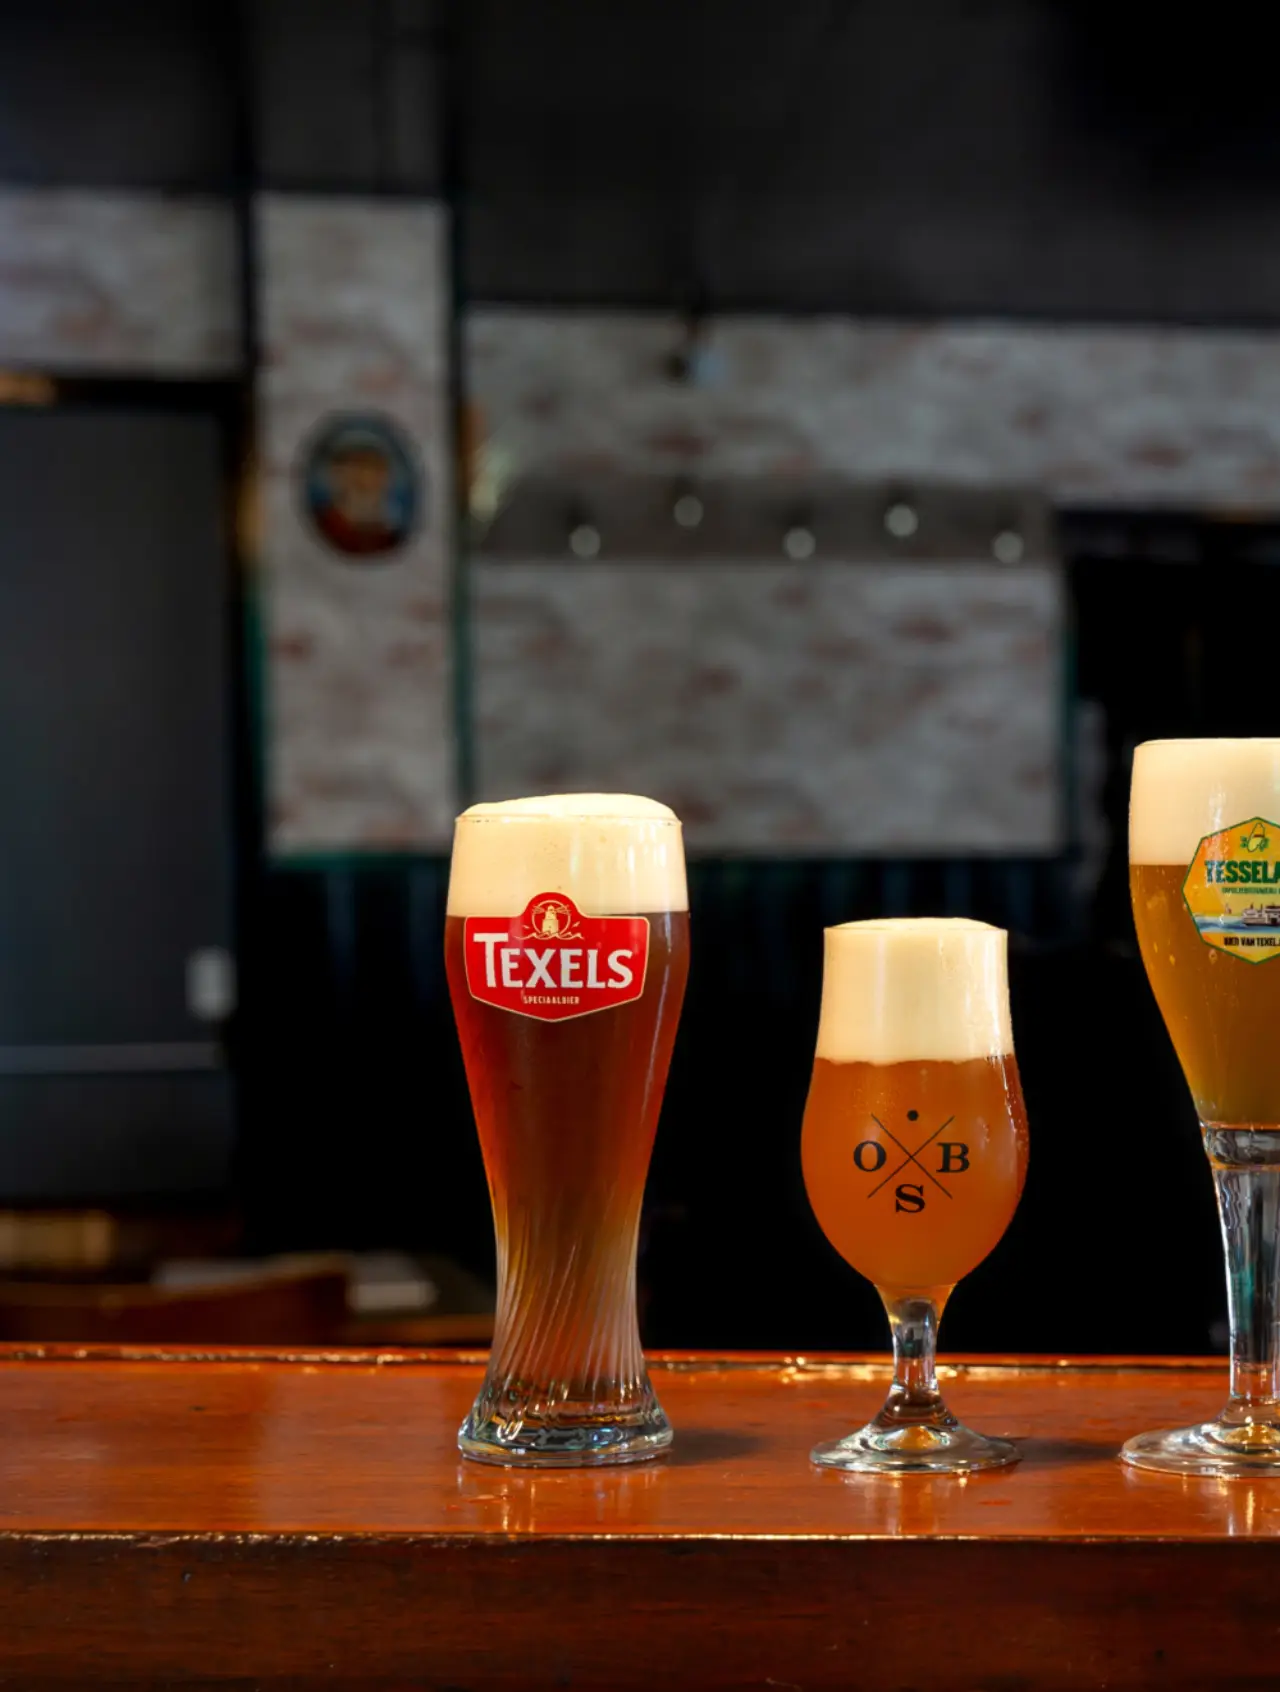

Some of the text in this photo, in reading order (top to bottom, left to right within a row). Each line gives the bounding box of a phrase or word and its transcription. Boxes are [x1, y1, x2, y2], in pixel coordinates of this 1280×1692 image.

[1241, 937, 1255, 946] VAN
[473, 932, 634, 989] TEXELS
[523, 995, 580, 1005] SPECIAALBIER
[853, 1140, 970, 1173] O B
[895, 1184, 926, 1214] S
